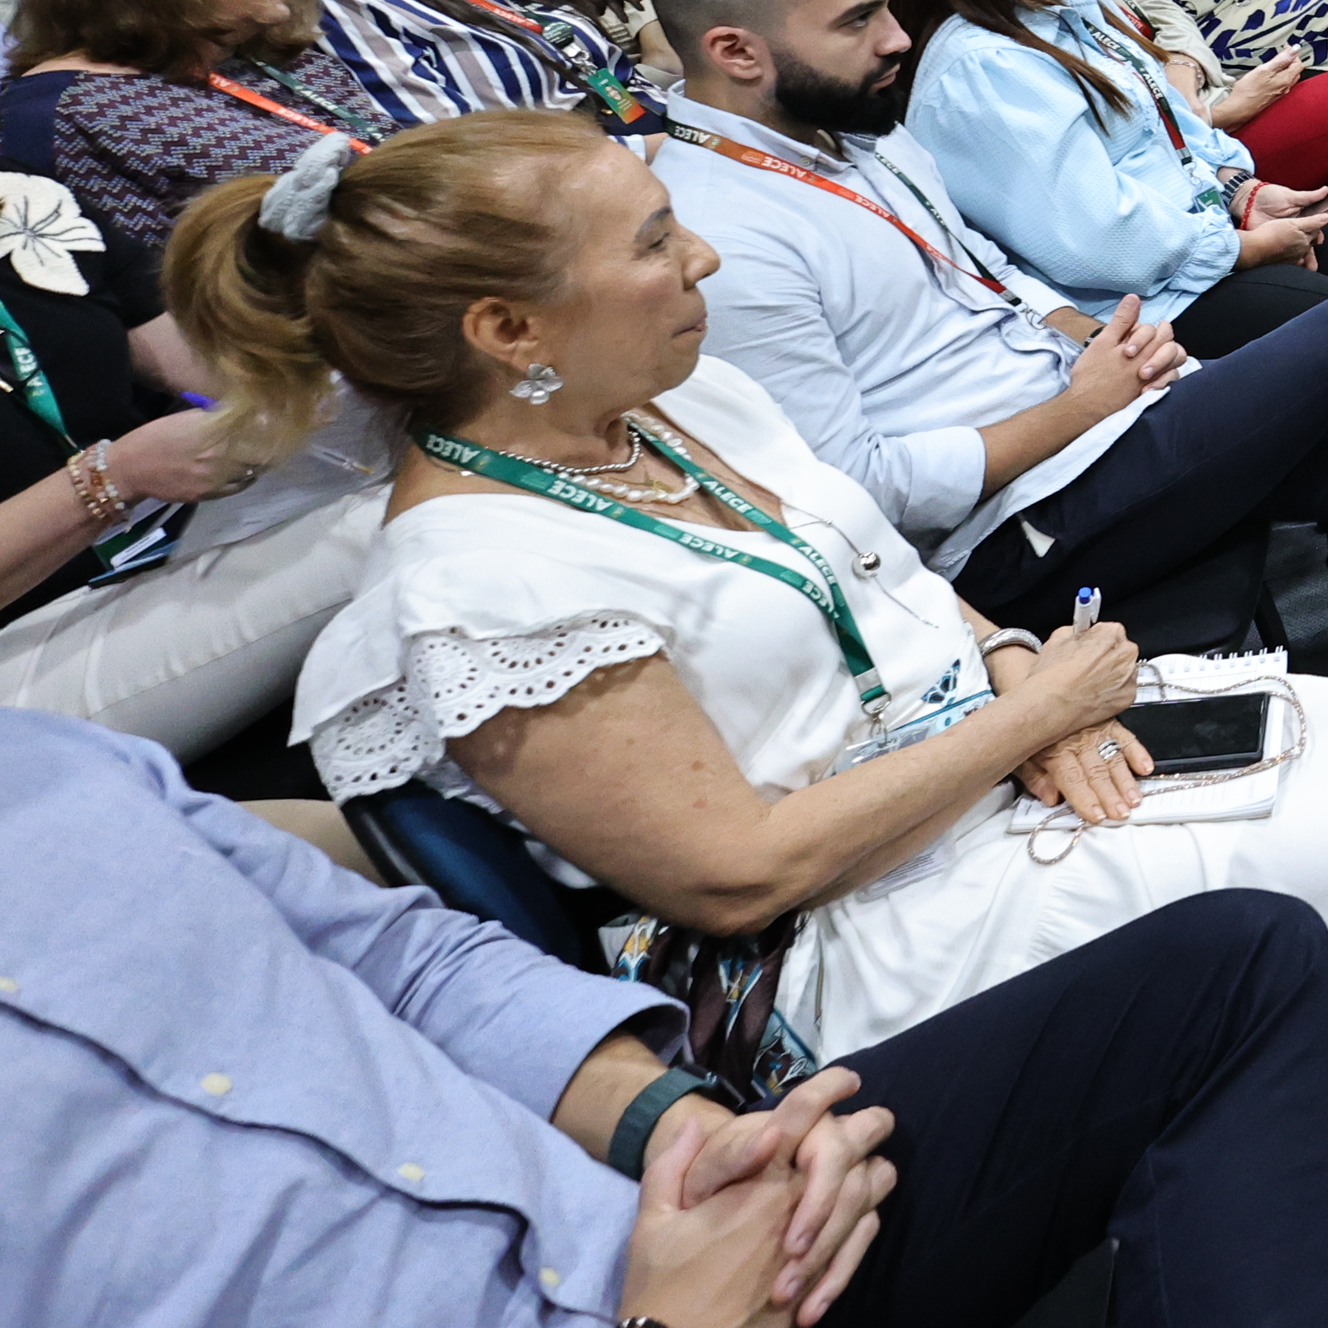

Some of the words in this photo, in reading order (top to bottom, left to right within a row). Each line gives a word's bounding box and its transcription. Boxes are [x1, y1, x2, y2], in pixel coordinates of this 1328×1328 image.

[1092, 31, 1120, 51] ALECE
[1142, 71, 1164, 100] ALECE
[674, 125, 712, 144] ALECE
[761, 156, 808, 178] ALECE
[853, 194, 890, 218] ALECE
[427, 434, 480, 464] ALECE
[547, 480, 614, 511] ALECE
[702, 480, 754, 514] ALECE
[678, 532, 741, 559] ALECE
[798, 545, 837, 585] ALECE
[802, 580, 839, 619] LECE
